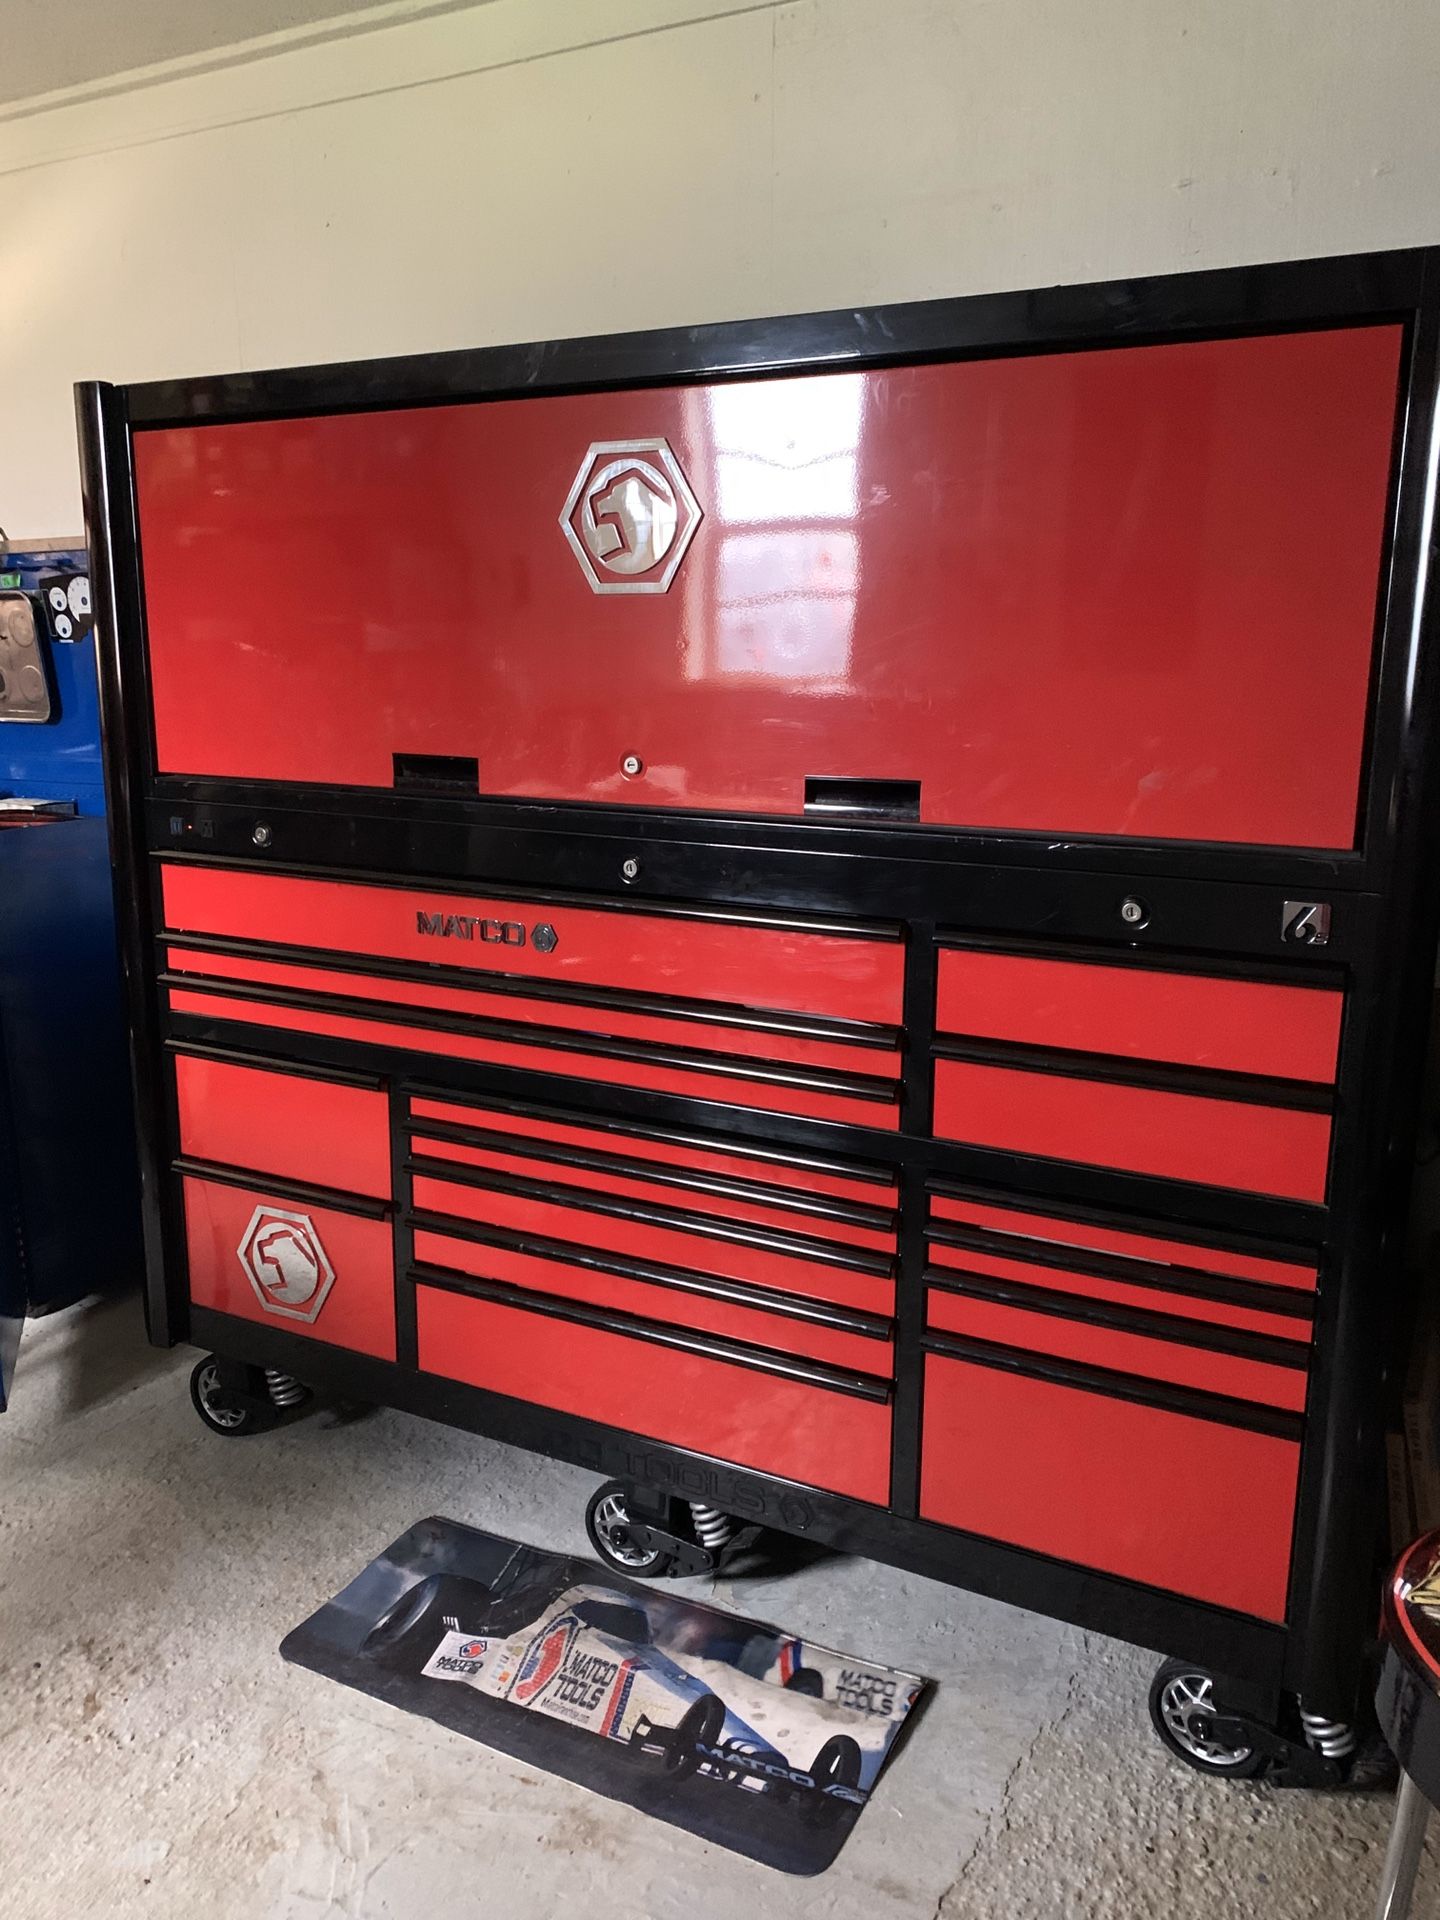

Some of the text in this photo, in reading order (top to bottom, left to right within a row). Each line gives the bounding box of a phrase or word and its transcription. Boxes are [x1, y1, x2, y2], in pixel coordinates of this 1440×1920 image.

[416, 911, 526, 947] MATCO
[623, 1450, 765, 1513] TOOLS
[567, 1650, 618, 1687] MATCO
[838, 1669, 897, 1697] MATCO
[554, 1674, 605, 1710] TOOLS
[836, 1685, 894, 1715] TOOLS
[695, 1743, 816, 1788] MATCO
